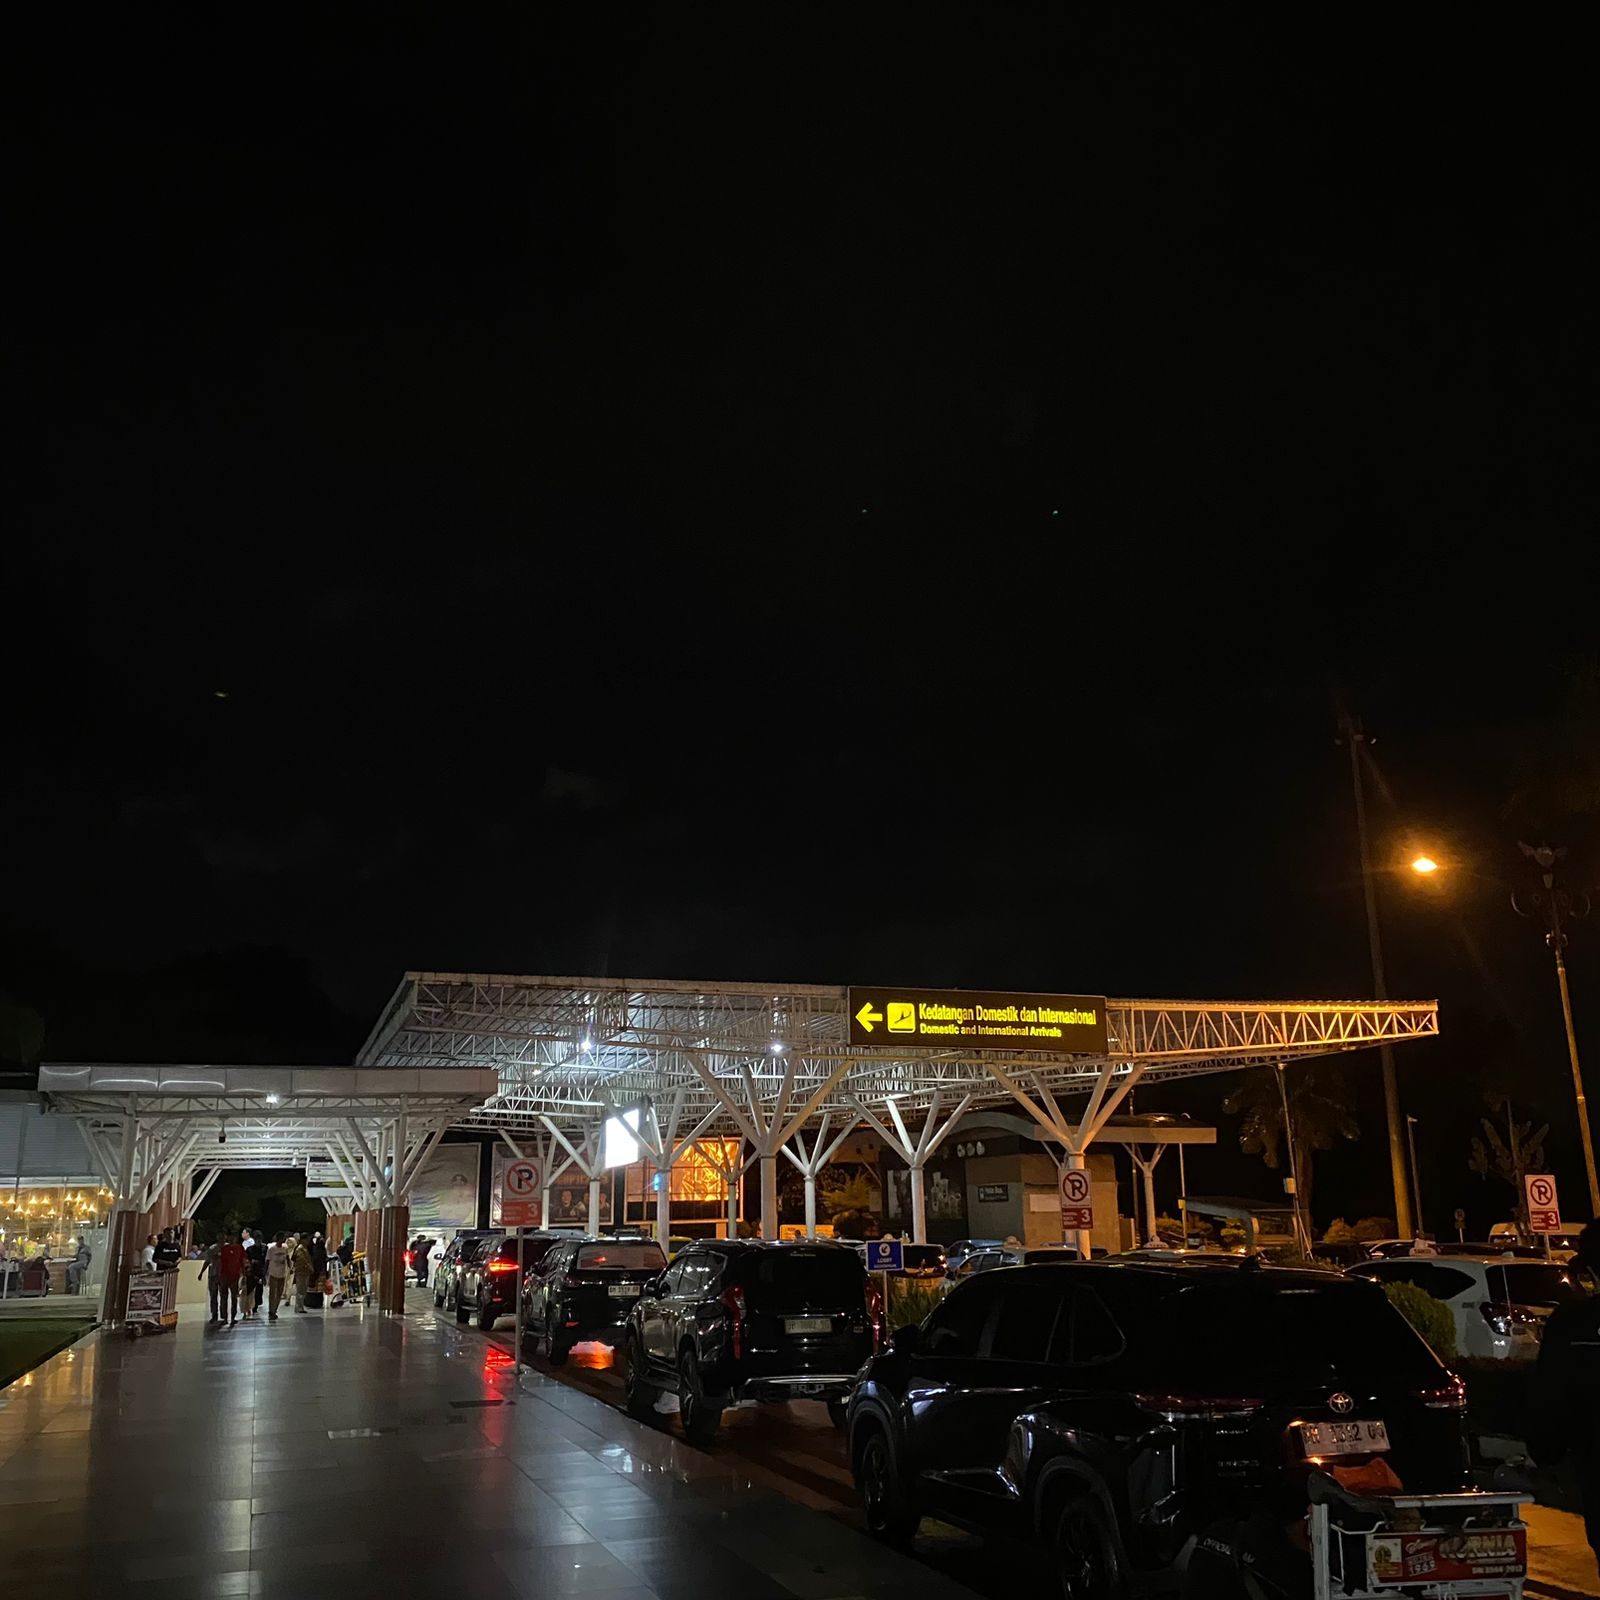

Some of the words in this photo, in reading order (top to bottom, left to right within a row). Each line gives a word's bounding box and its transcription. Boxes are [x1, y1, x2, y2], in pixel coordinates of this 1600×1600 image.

[919, 1003, 974, 1024] Kedatangan
[975, 1005, 1019, 1022] Domestik
[1020, 1006, 1037, 1022] dan
[1038, 1007, 1097, 1025] Internasional
[920, 1023, 960, 1034] Domestic
[960, 1025, 977, 1035] and
[978, 1025, 1029, 1036] International
[1030, 1026, 1062, 1037] Arrivals
[527, 1202, 538, 1217] 3
[1081, 1209, 1091, 1222] 3
[1548, 1212, 1557, 1224] 3
